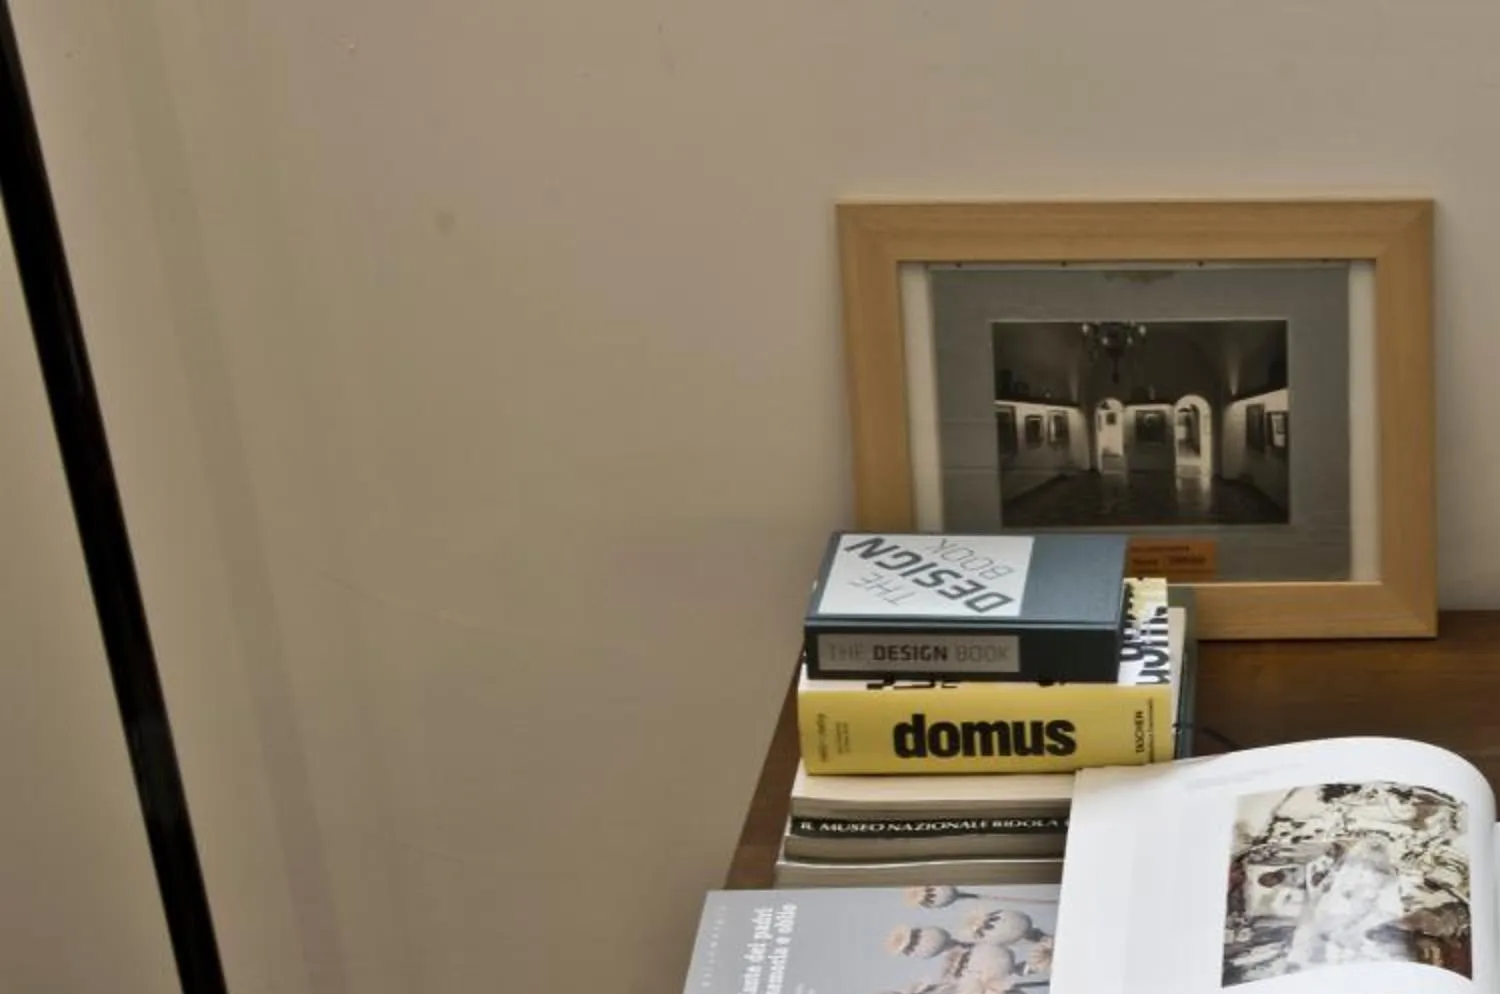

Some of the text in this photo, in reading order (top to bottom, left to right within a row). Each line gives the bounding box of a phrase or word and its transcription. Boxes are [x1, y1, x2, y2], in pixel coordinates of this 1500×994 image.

[844, 537, 1014, 613] THE DESIGN BOOK
[828, 642, 1009, 662] THE DESIGN BOOK
[893, 713, 1077, 758] domus
[819, 823, 885, 833] MUSEO
[886, 819, 987, 831] NAZIONALE
